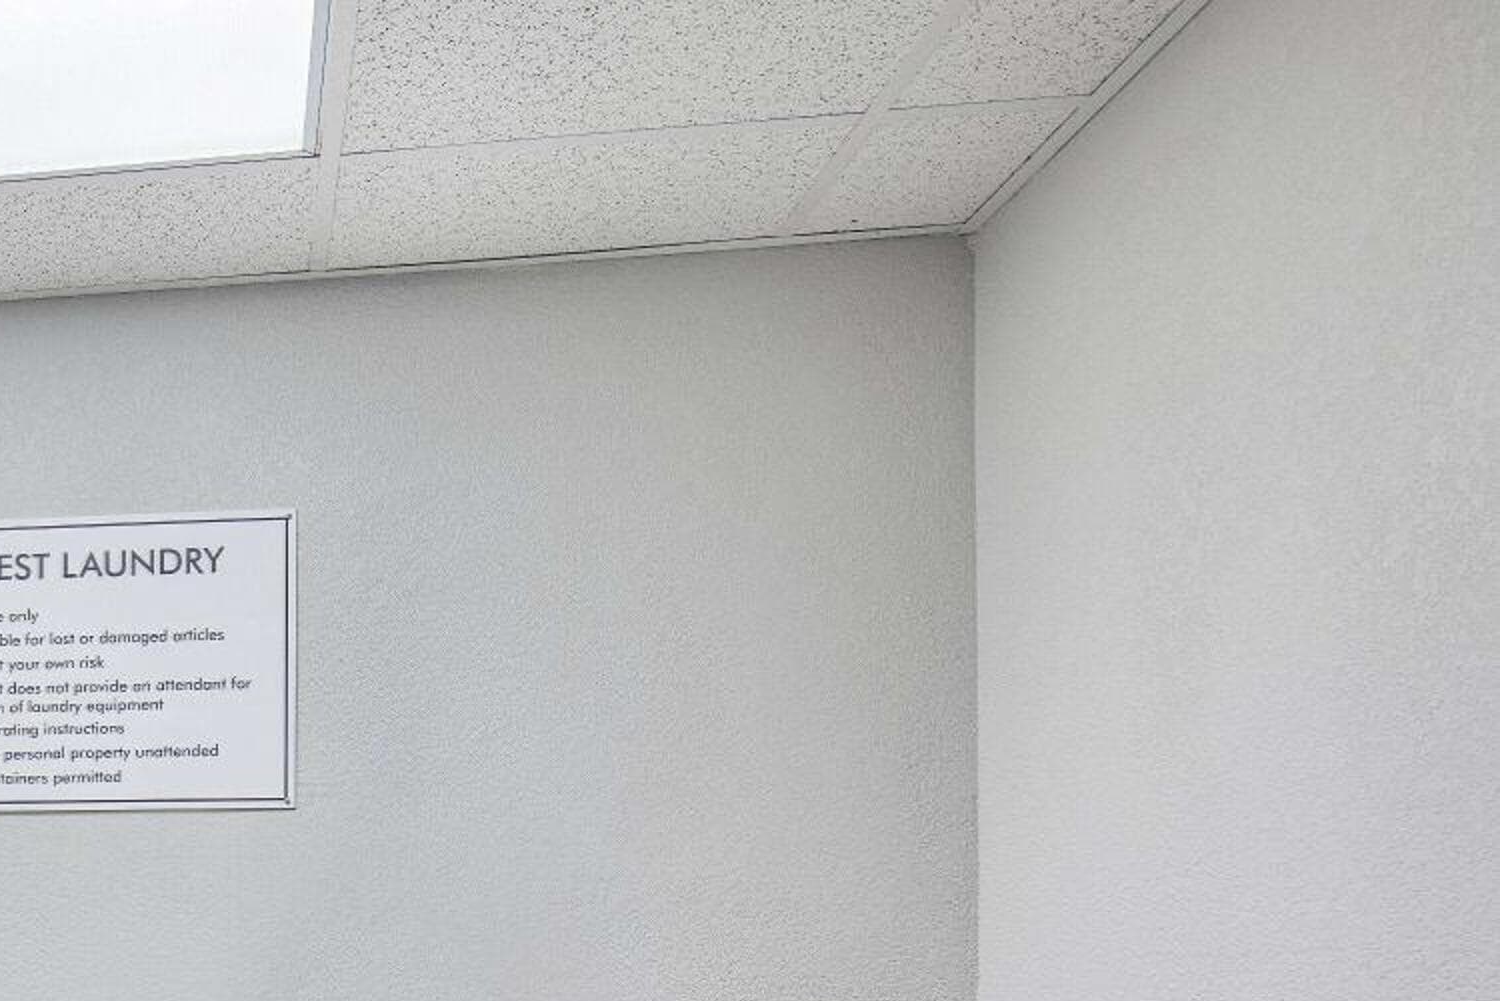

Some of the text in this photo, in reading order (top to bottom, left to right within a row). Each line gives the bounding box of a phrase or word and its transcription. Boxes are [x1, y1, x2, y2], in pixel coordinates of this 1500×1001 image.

[63, 546, 225, 579] LAUNDRY
[9, 608, 39, 625] only
[25, 632, 44, 646] for
[50, 632, 75, 646] lost
[79, 634, 94, 645] or
[99, 629, 168, 646] damaged
[173, 627, 225, 642] articles
[9, 658, 40, 673] your
[45, 659, 75, 670] own
[79, 656, 105, 669] risk
[8, 682, 41, 695] does
[45, 682, 69, 694] not
[73, 679, 127, 696] provide
[133, 681, 150, 692] an
[155, 677, 227, 692] attendant
[231, 676, 251, 689] for
[9, 701, 23, 714] of
[28, 700, 82, 715] laundry
[87, 699, 164, 714] equipment
[43, 721, 125, 736] instructions
[4, 746, 65, 763] personal
[70, 746, 131, 762] property
[135, 743, 219, 758] unattended
[53, 770, 122, 787] permitted
